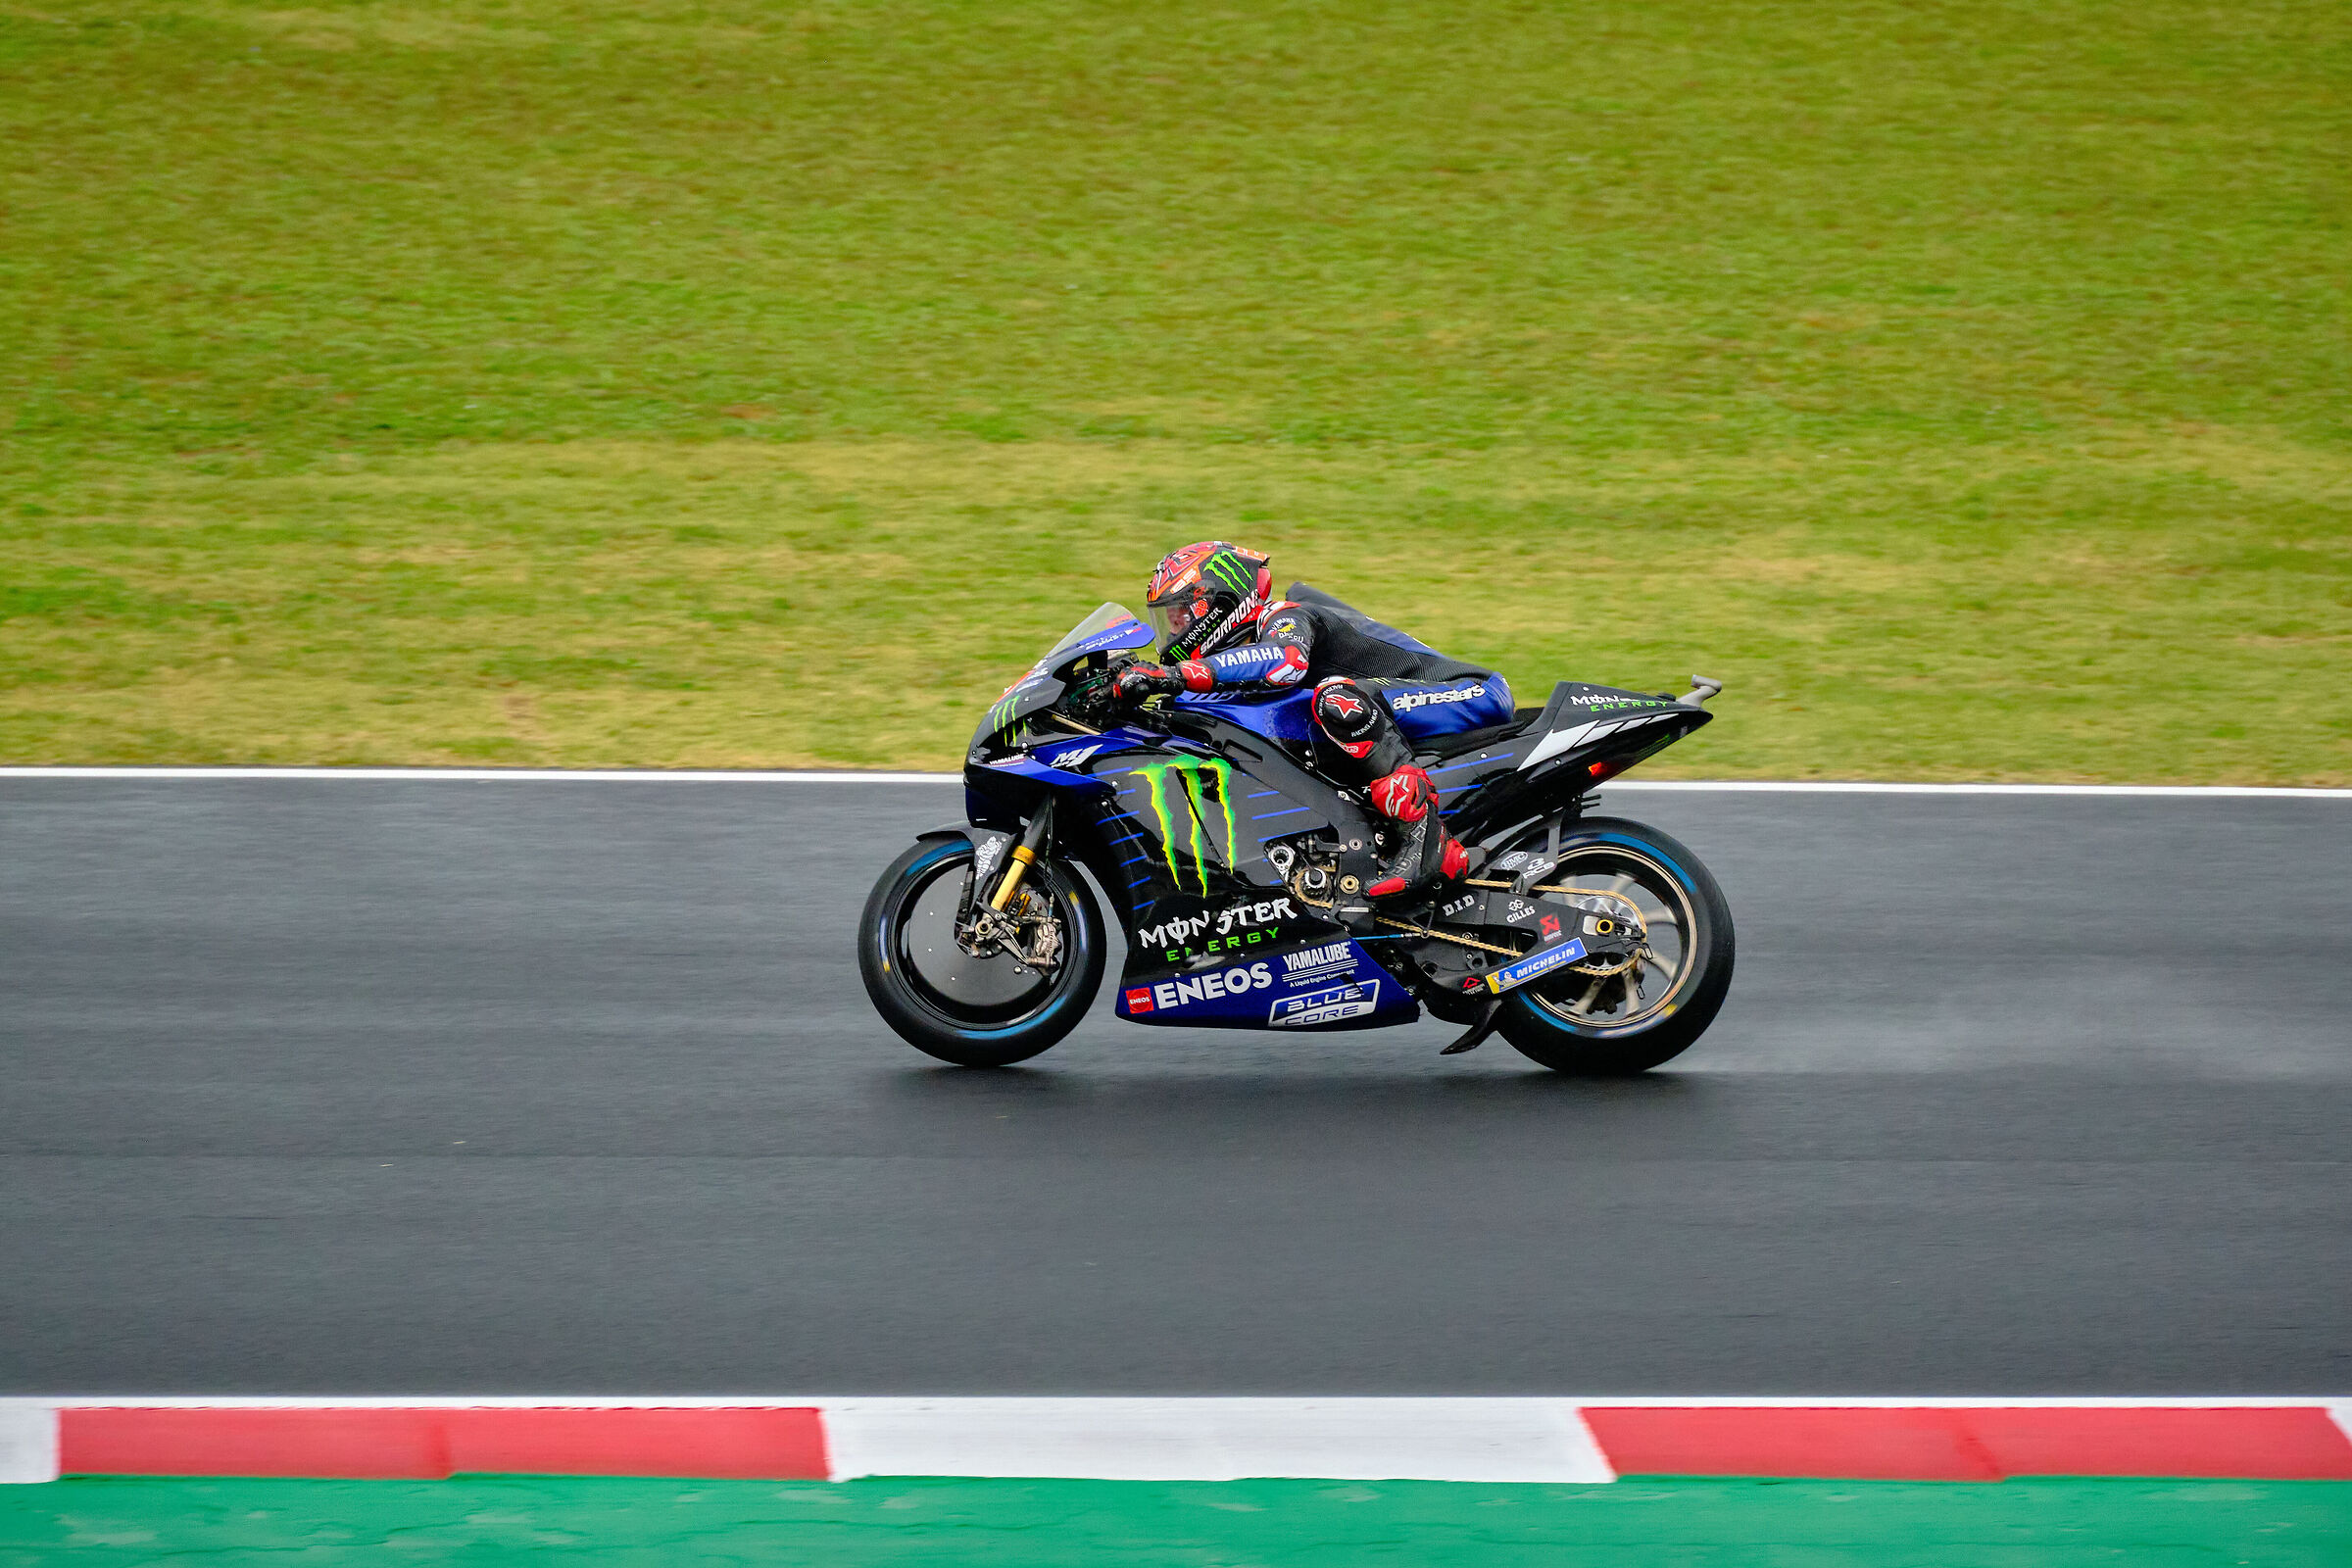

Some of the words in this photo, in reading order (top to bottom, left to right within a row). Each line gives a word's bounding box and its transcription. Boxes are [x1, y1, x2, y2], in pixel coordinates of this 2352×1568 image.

[1182, 607, 1223, 647] MONSTER
[1200, 589, 1255, 655] SCORPION
[1215, 646, 1285, 667] YAMAHA
[1393, 684, 1486, 712] alpinestars
[1590, 700, 1668, 711] ENERGY
[1442, 894, 1475, 917] D.I.D
[1506, 906, 1536, 923] GILLES
[1138, 897, 1298, 949] MONSTER
[1282, 942, 1352, 971] YAMALUBE
[1516, 947, 1576, 978] MICHELIN
[1153, 962, 1273, 1009] ENEOS
[1295, 979, 1310, 988] Liquid
[1309, 975, 1327, 984] Engine
[1287, 987, 1363, 1012] BLUE
[1286, 1004, 1359, 1025] CORE
